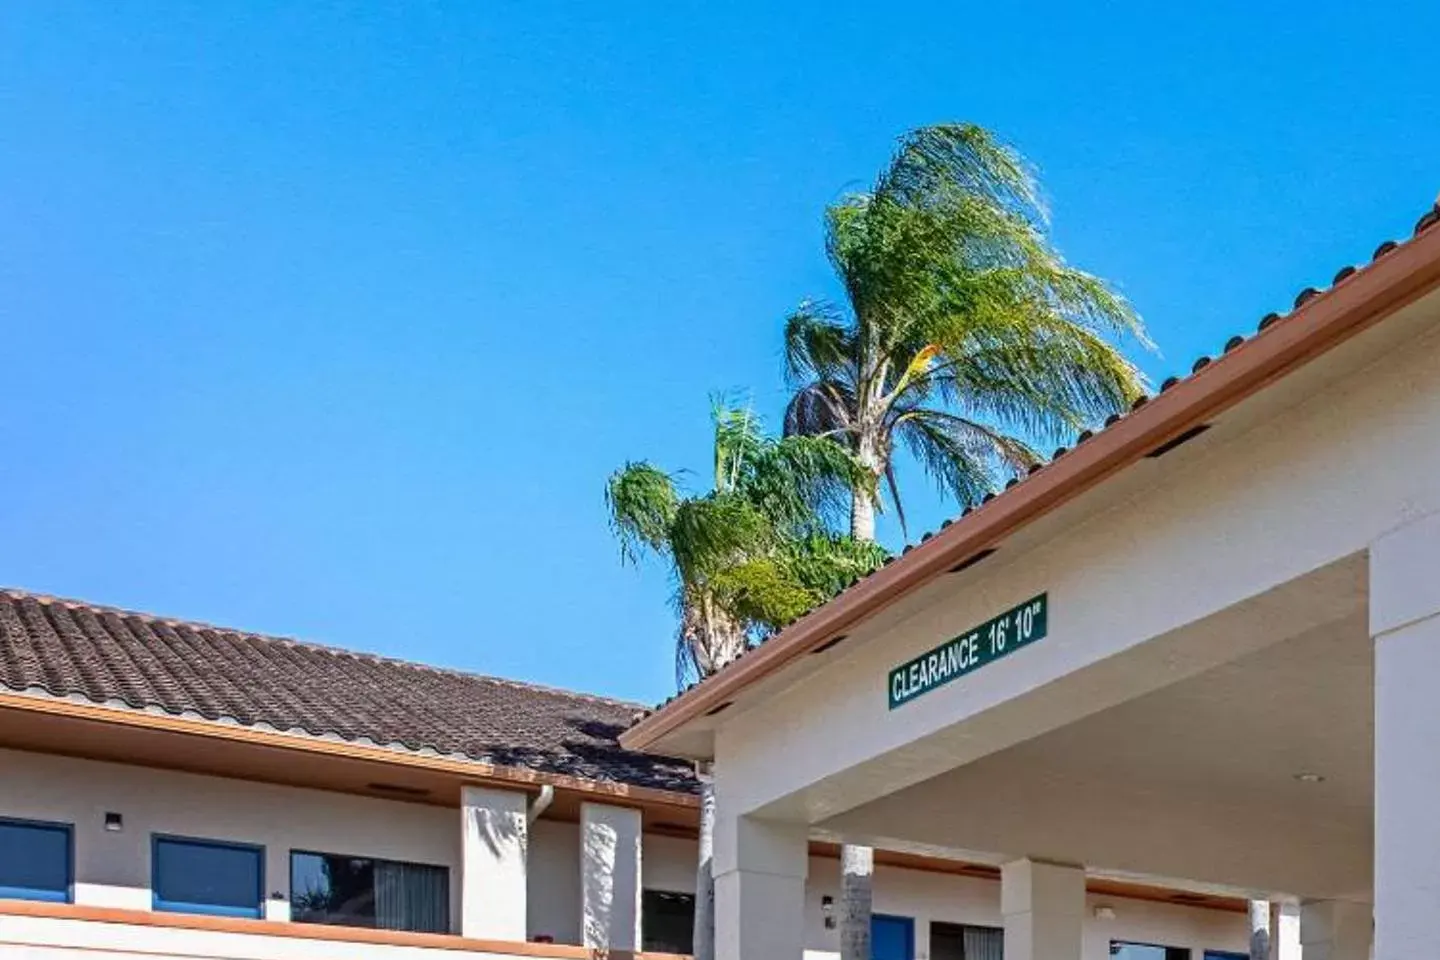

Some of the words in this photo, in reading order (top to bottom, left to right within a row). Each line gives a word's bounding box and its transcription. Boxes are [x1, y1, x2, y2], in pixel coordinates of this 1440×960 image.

[892, 632, 979, 702] CLEARANCE
[988, 616, 1010, 655] 16'
[1015, 601, 1042, 642] 10"
